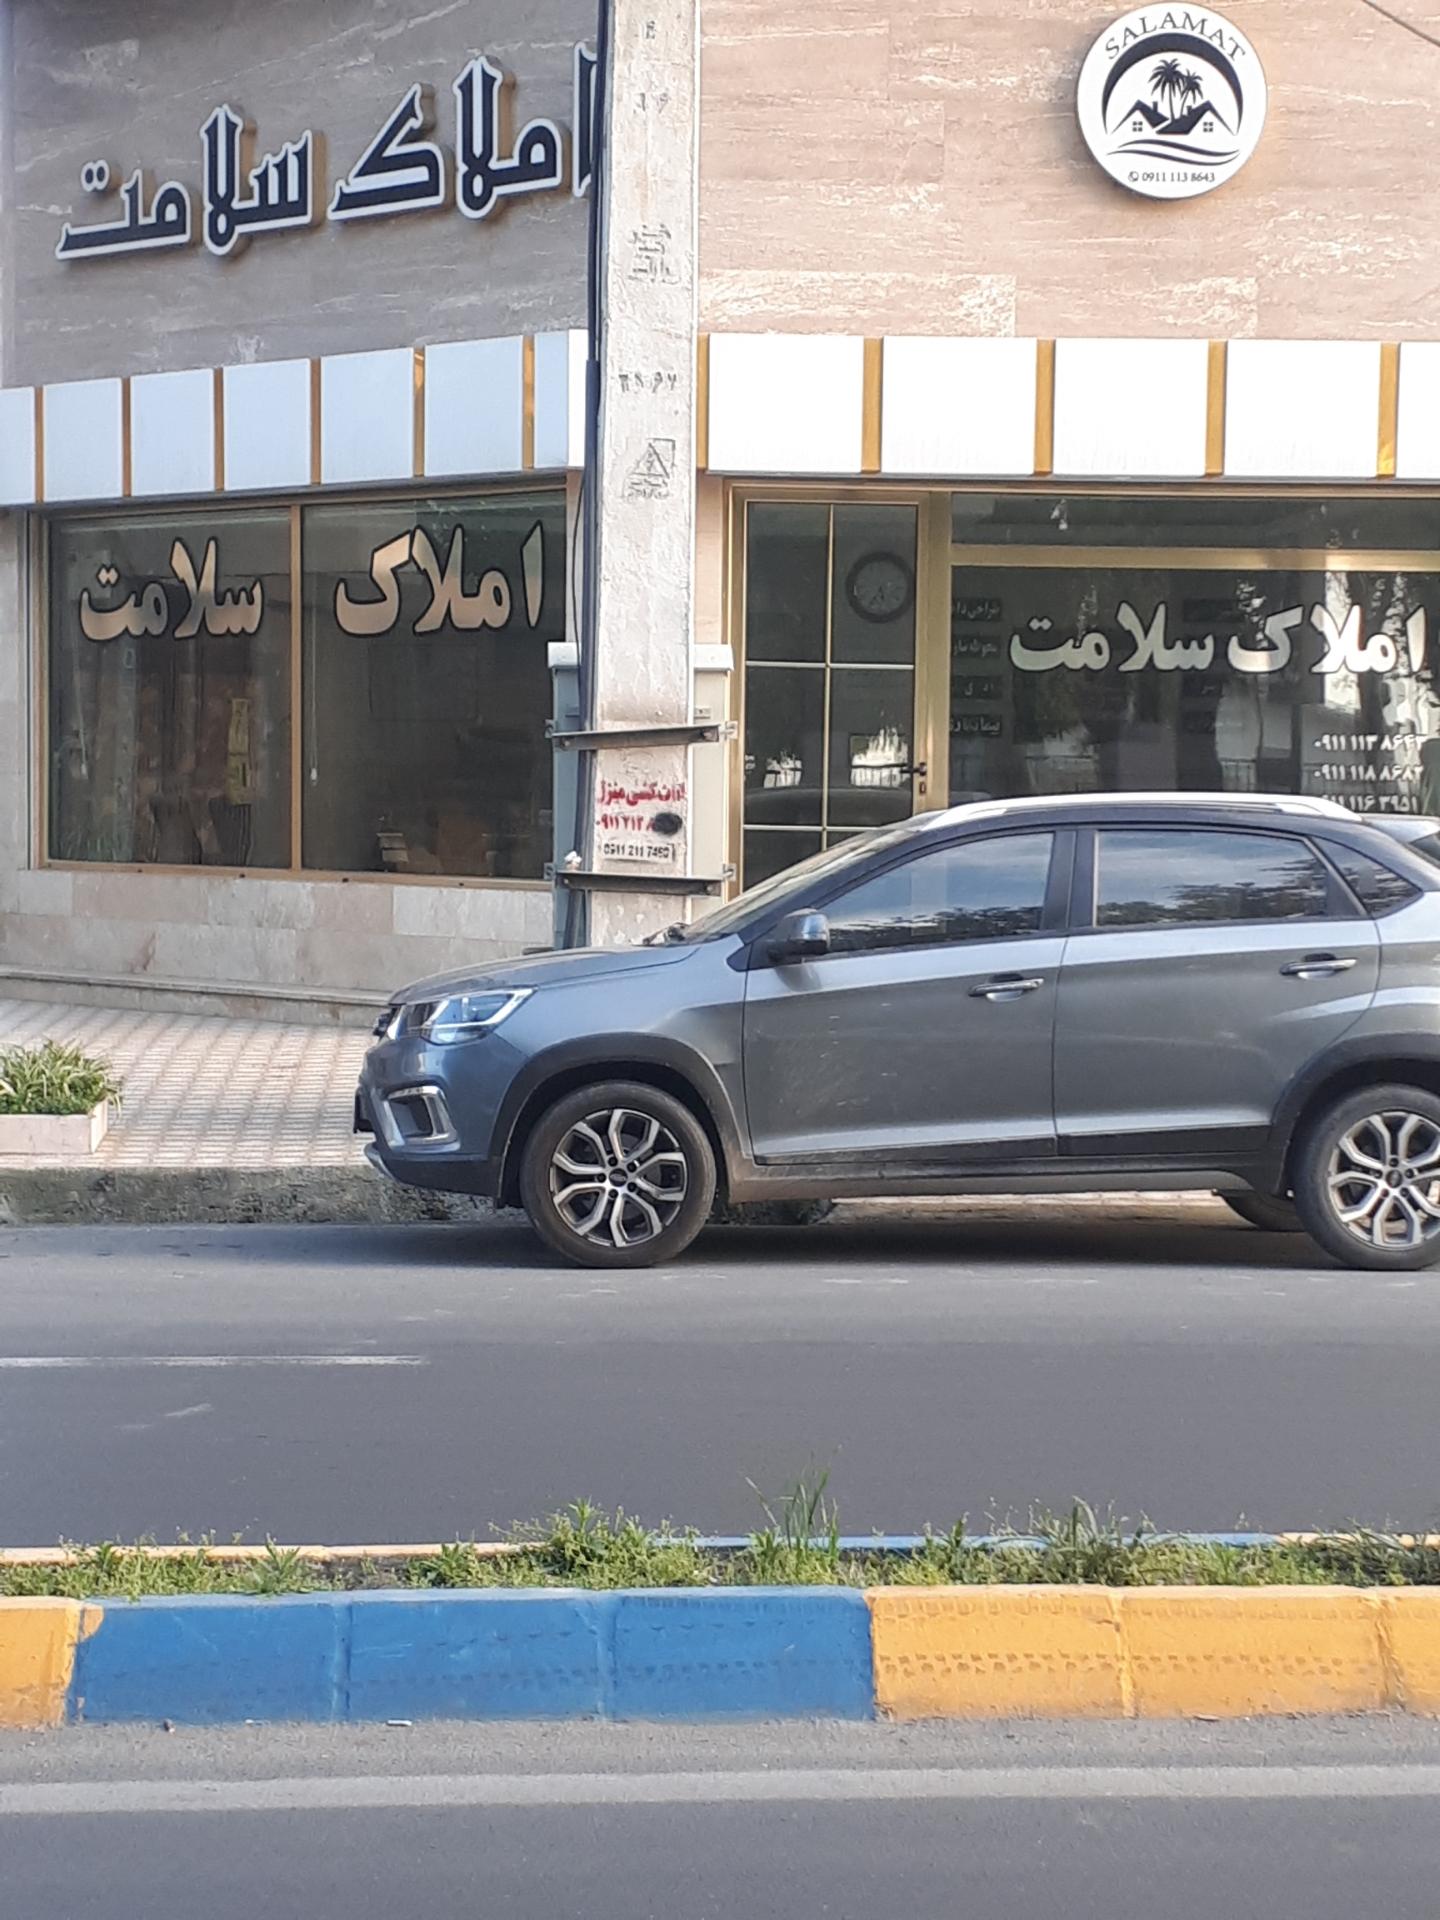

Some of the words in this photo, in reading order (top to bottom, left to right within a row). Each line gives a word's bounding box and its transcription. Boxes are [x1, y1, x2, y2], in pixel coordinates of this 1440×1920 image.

[1104, 11, 1246, 60] SALAMAT
[327, 41, 598, 220] املاک
[55, 103, 313, 260] سلامت
[1142, 171, 1166, 183] 0911
[1170, 171, 1188, 183] 113
[80, 537, 265, 641] سلامت
[334, 520, 544, 636] املاک
[1008, 601, 1215, 673] سلامت
[1227, 602, 1428, 675] املاک
